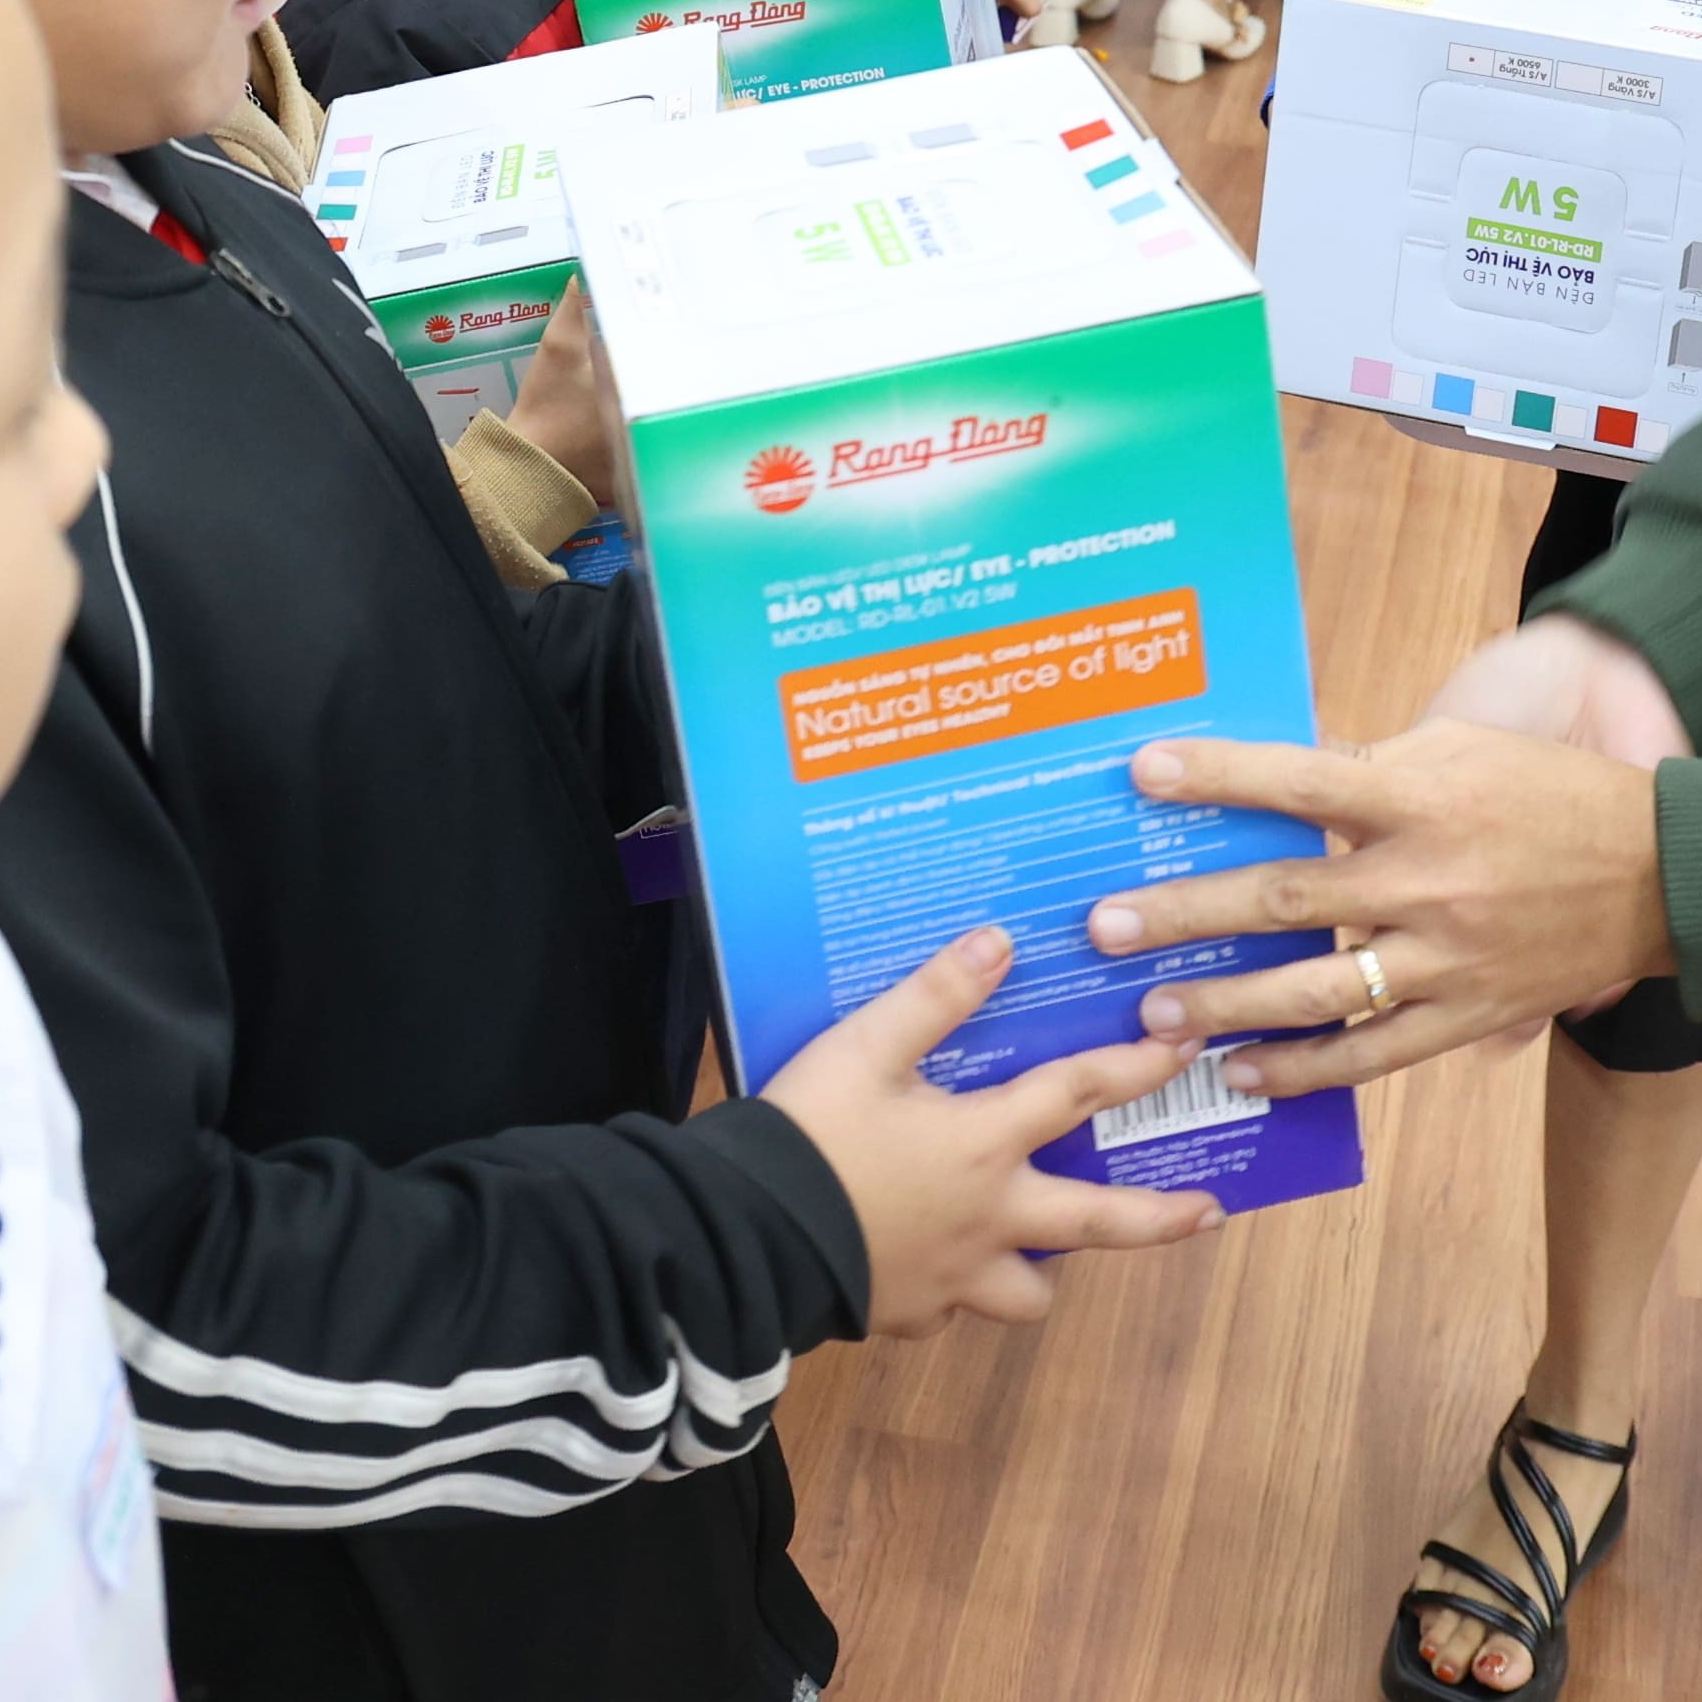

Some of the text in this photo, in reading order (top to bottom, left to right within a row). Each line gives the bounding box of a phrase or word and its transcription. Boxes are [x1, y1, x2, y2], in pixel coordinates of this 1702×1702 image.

[1508, 56, 1541, 70] 6500 K
[744, 75, 768, 85] LAMP
[767, 82, 791, 97] EYE
[801, 67, 886, 92] PROTECTION
[1528, 70, 1548, 82] A/S
[1617, 75, 1650, 88] 3000 K
[1637, 89, 1656, 100] A/S
[1499, 177, 1580, 222] 5 W
[1474, 224, 1499, 240] 5W
[1465, 246, 1595, 287] BẢO VỆ THỊ LỰC
[1463, 268, 1595, 306] ĐÈN BÀN LED
[766, 594, 822, 624] BẢO
[826, 583, 858, 613] VỆ
[861, 578, 901, 604] THỊ
[970, 554, 1012, 582] EYE
[1028, 519, 1177, 569] PROTECTION
[794, 627, 1192, 741] Natural source of light
